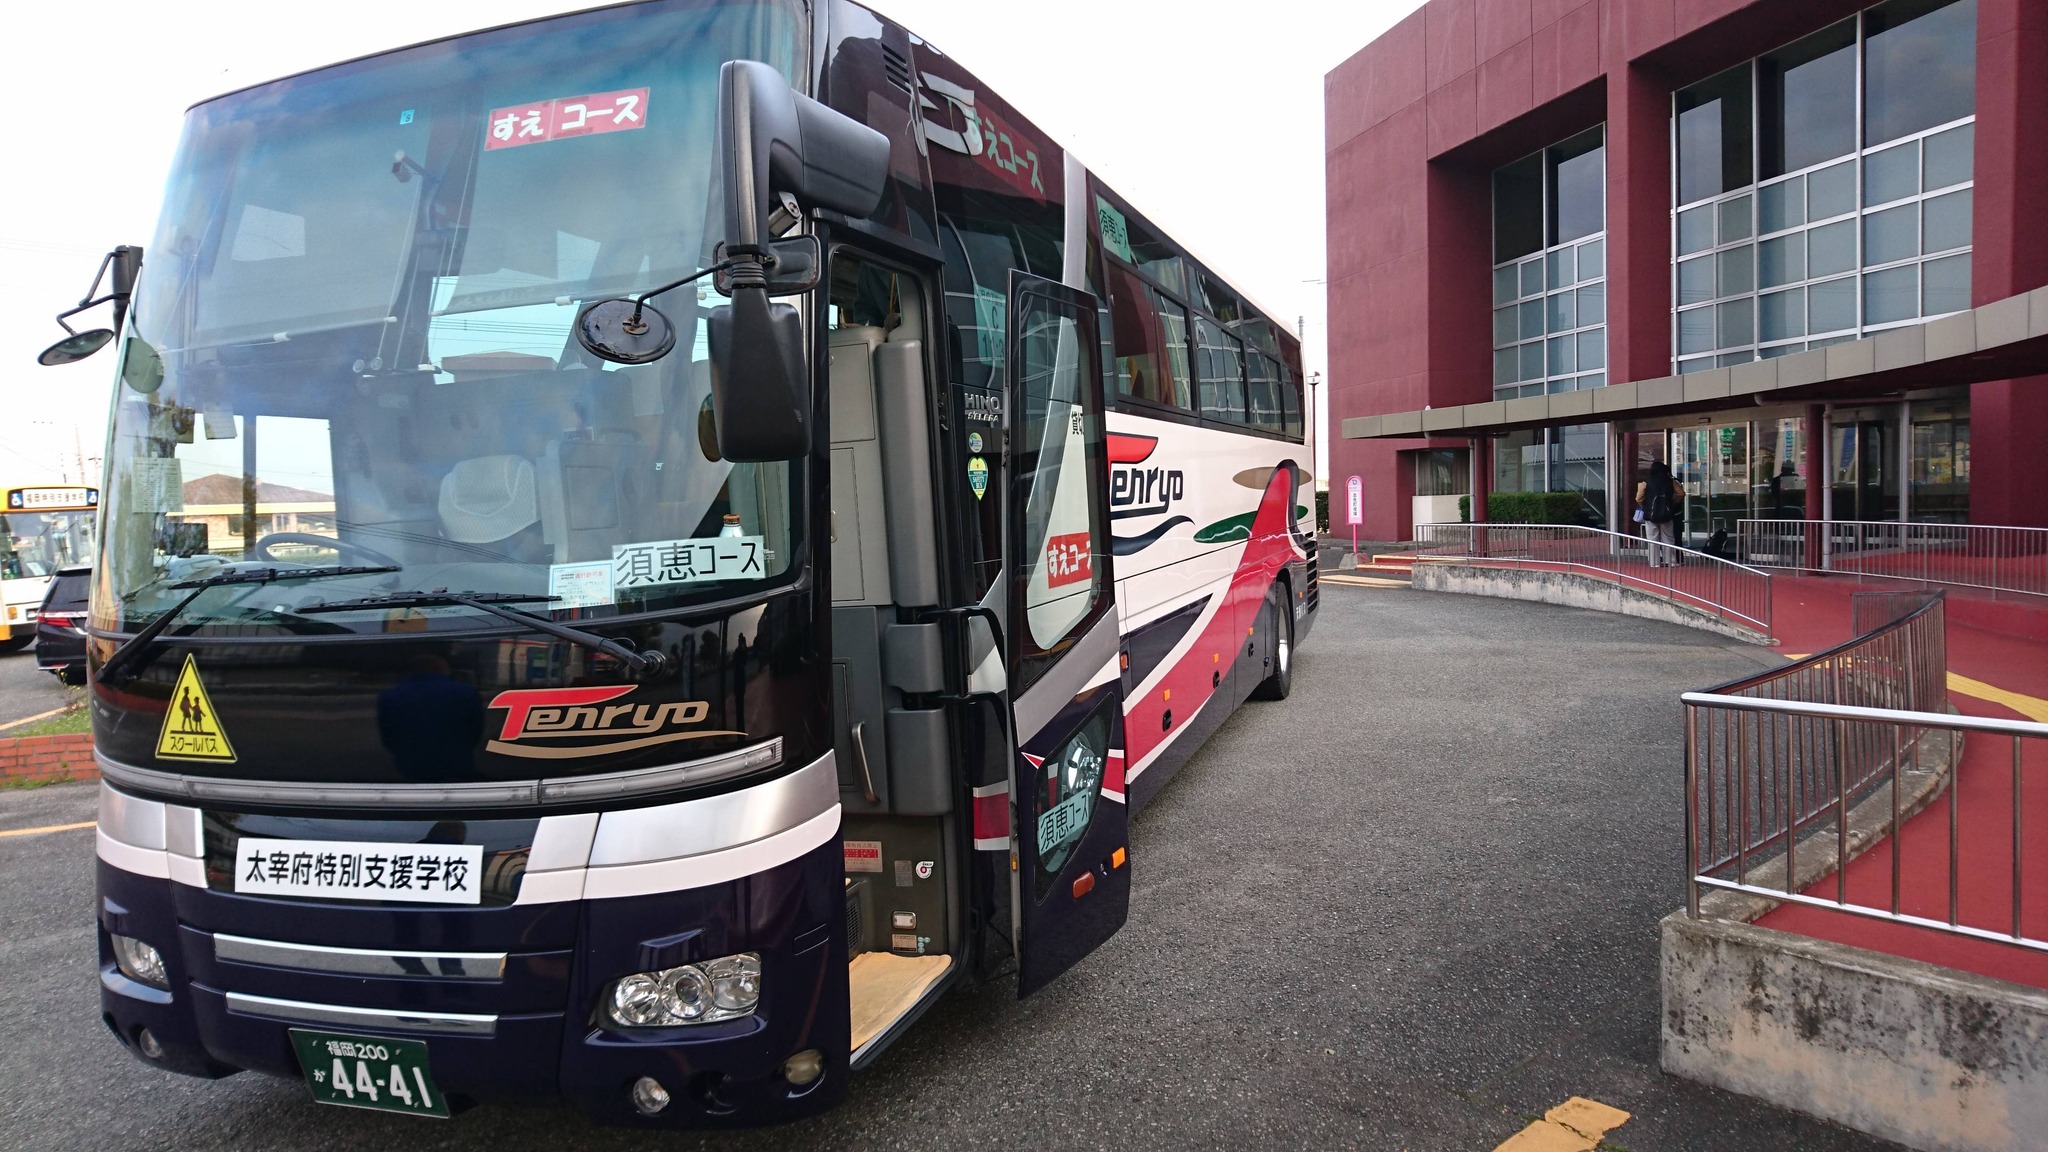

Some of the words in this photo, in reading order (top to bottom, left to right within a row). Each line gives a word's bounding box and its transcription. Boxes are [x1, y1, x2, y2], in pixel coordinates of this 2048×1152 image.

[967, 107, 1044, 194] えコース
[964, 392, 1000, 413] HINO
[616, 542, 761, 586] 須恵コース
[487, 684, 710, 741] Tenryo
[170, 736, 219, 753] スクールバス
[1040, 793, 1089, 852] 須恵コース
[245, 849, 469, 892] 太宰府特別支援学校
[313, 1068, 326, 1083] か
[332, 1057, 433, 1108] 44-41
